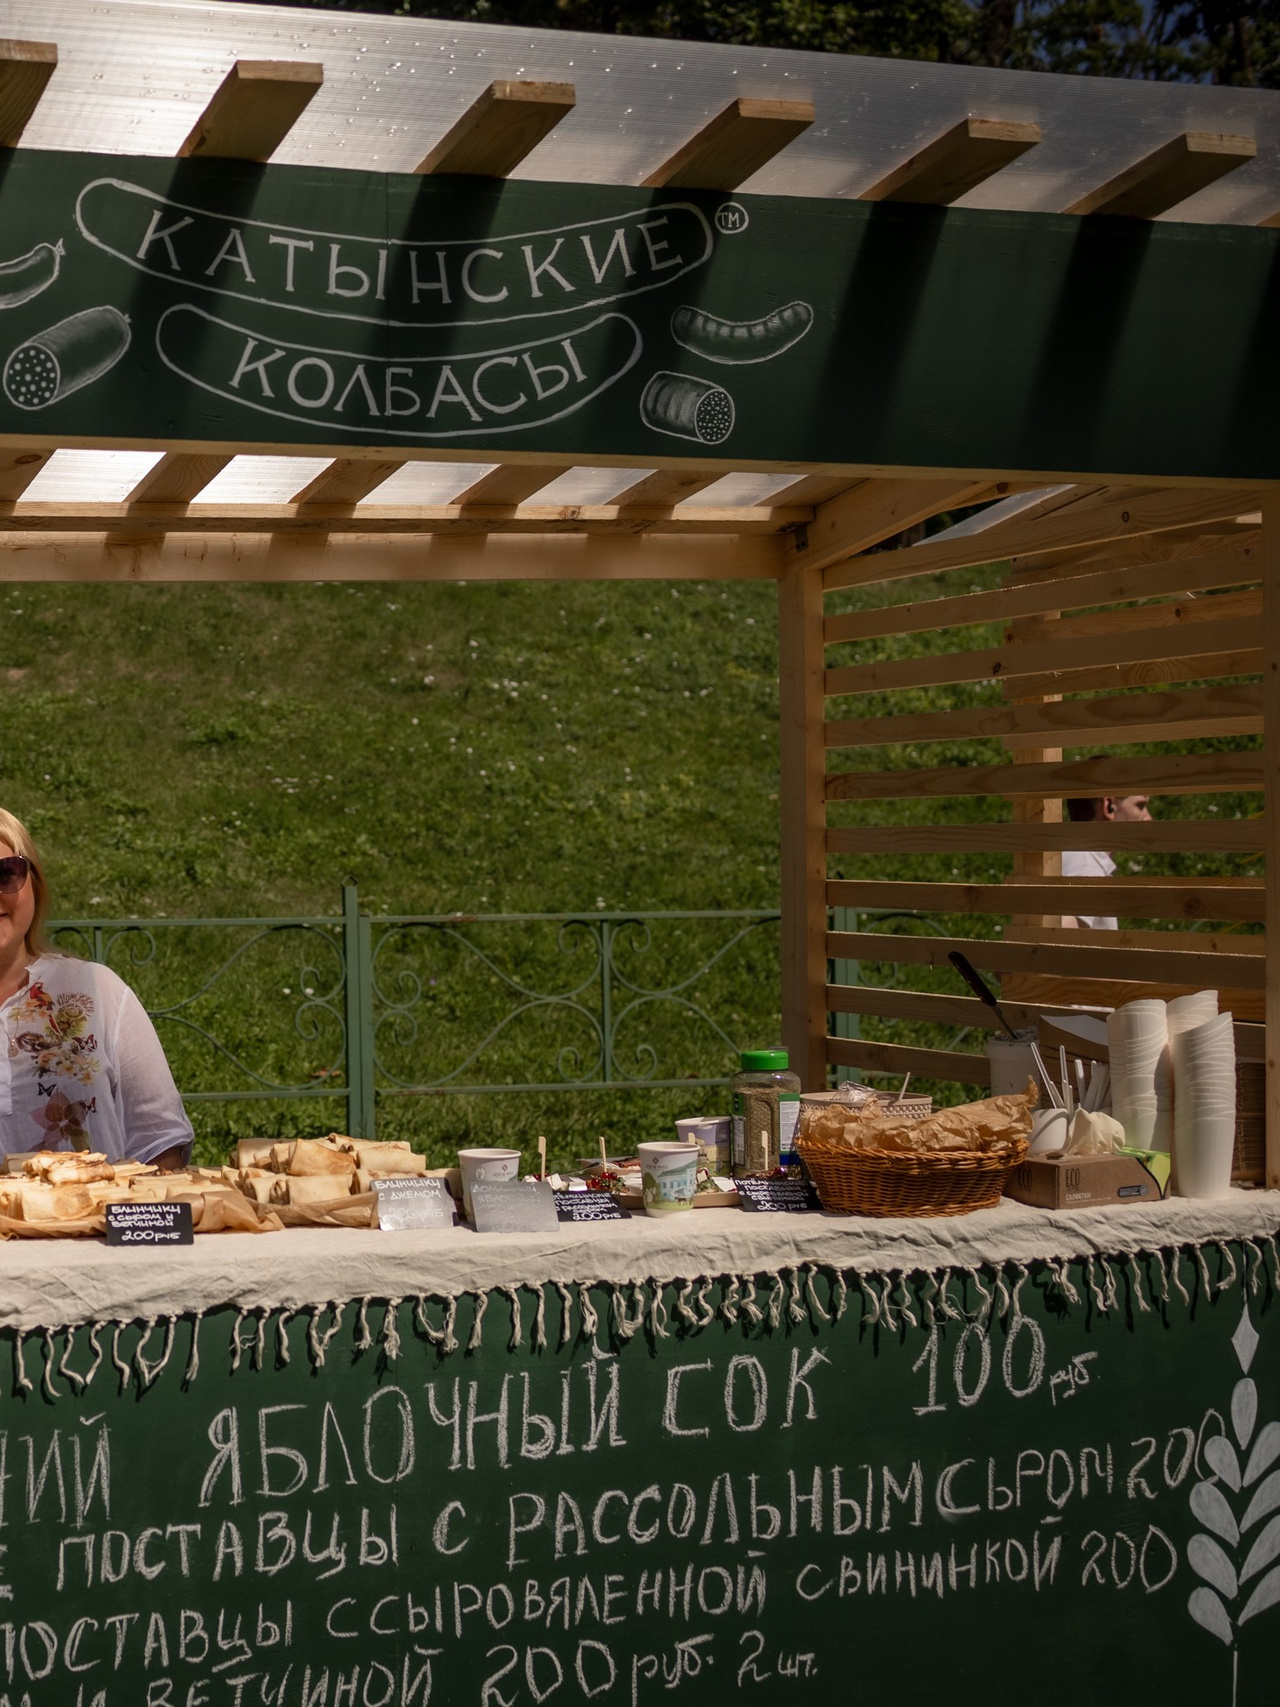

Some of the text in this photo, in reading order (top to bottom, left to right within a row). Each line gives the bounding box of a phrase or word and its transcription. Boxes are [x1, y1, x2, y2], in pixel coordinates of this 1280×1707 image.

[135, 208, 685, 305] КАТЫНСКИЕ
[227, 337, 589, 423] КОЛБАСЫ
[198, 1334, 628, 1507] ЯБЛОЧНЫЙ
[662, 1345, 832, 1439] СОК
[911, 1314, 1047, 1417] 100
[56, 1503, 399, 1592] ПОСТАВЦЫ
[431, 1500, 470, 1556] С
[506, 1459, 924, 1568] РАССОЛЬНЫМ
[934, 1442, 1114, 1512] СЫРОМ
[795, 1515, 1063, 1601] СВИНИНКОЙ
[1080, 1523, 1179, 1595] 200
[480, 1639, 619, 1707] 200
[737, 1630, 772, 1688] 2
